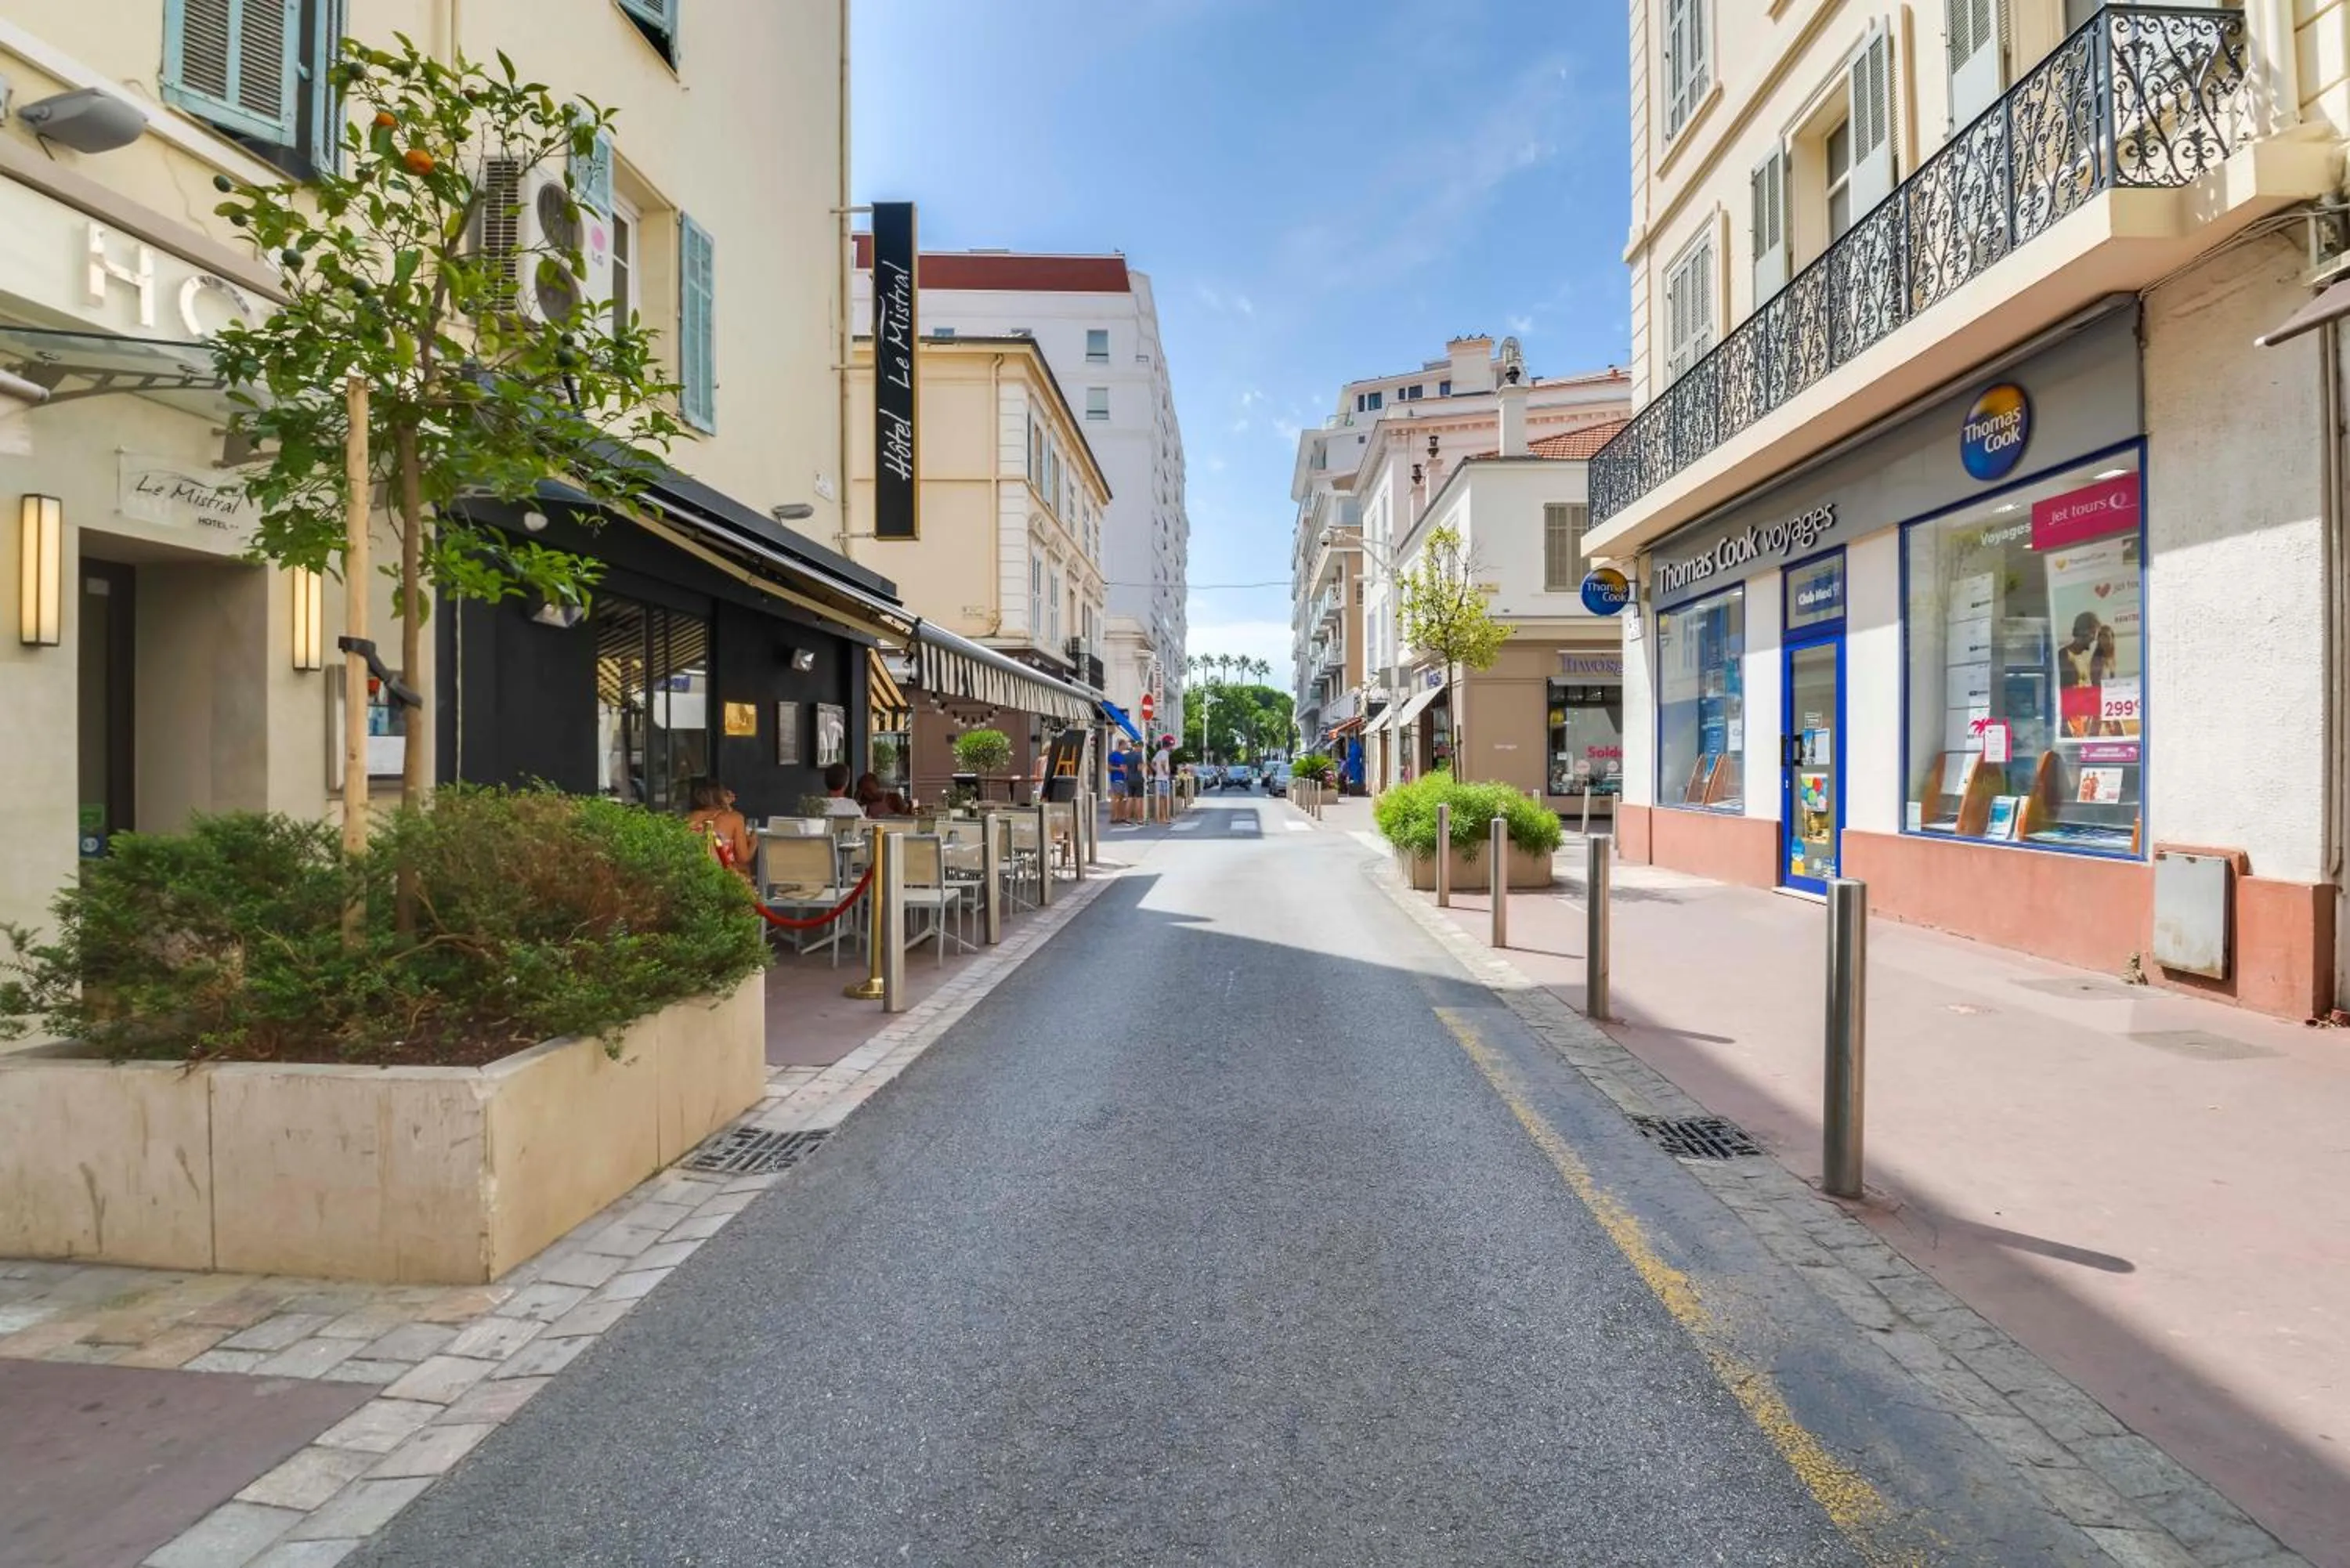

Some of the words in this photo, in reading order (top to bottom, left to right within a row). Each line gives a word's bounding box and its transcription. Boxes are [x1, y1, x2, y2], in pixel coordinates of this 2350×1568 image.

[881, 259, 910, 351] Mistral
[888, 356, 911, 389] Le
[1964, 406, 2021, 444] Thomas
[1984, 424, 2021, 453] Cook
[878, 408, 913, 481] Hôtel
[136, 474, 164, 496] Le
[169, 483, 245, 515] Mistral
[2071, 499, 2107, 518] tours
[1657, 550, 1714, 594] Thomas
[1716, 526, 1760, 571] Cook
[1762, 503, 1835, 556] voyages
[1585, 582, 1629, 593] Thomas
[1602, 591, 1629, 602] Cook
